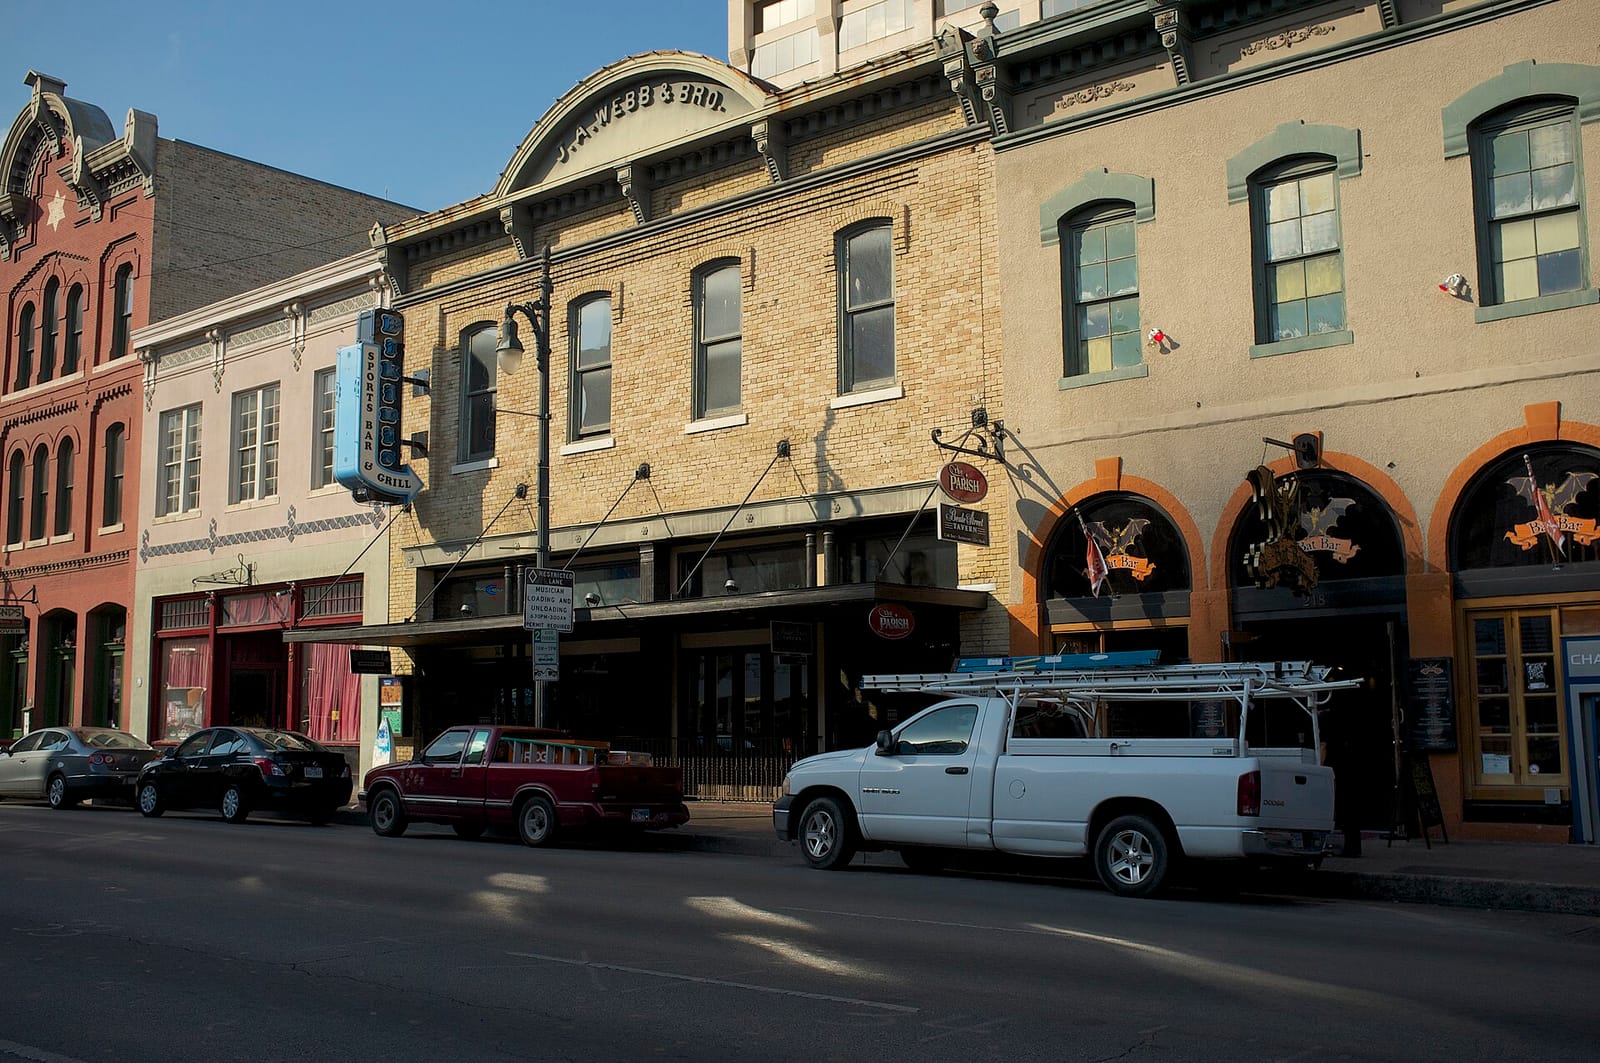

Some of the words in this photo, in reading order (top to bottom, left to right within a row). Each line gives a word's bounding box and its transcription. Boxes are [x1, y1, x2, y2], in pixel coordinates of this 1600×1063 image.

[595, 85, 654, 127] WEBB
[659, 82, 675, 104] &
[679, 83, 727, 113] BRO.
[366, 352, 375, 412] SPORTS
[364, 421, 374, 451] BAR
[363, 461, 374, 471] &
[377, 473, 412, 489] GRILL
[953, 523, 978, 534] TAVERN
[1559, 518, 1584, 531] Bar
[1321, 537, 1342, 550] Bar
[1121, 556, 1140, 568] Bar
[538, 571, 574, 580] RESTRICTED
[535, 586, 565, 594] MUSICIAN
[527, 595, 556, 604] LOADING
[1303, 593, 1326, 607] 218
[530, 605, 568, 614] UNLOADING
[534, 630, 542, 642] 2
[1571, 653, 1600, 665] CHA
[1263, 799, 1286, 807] DODGE
